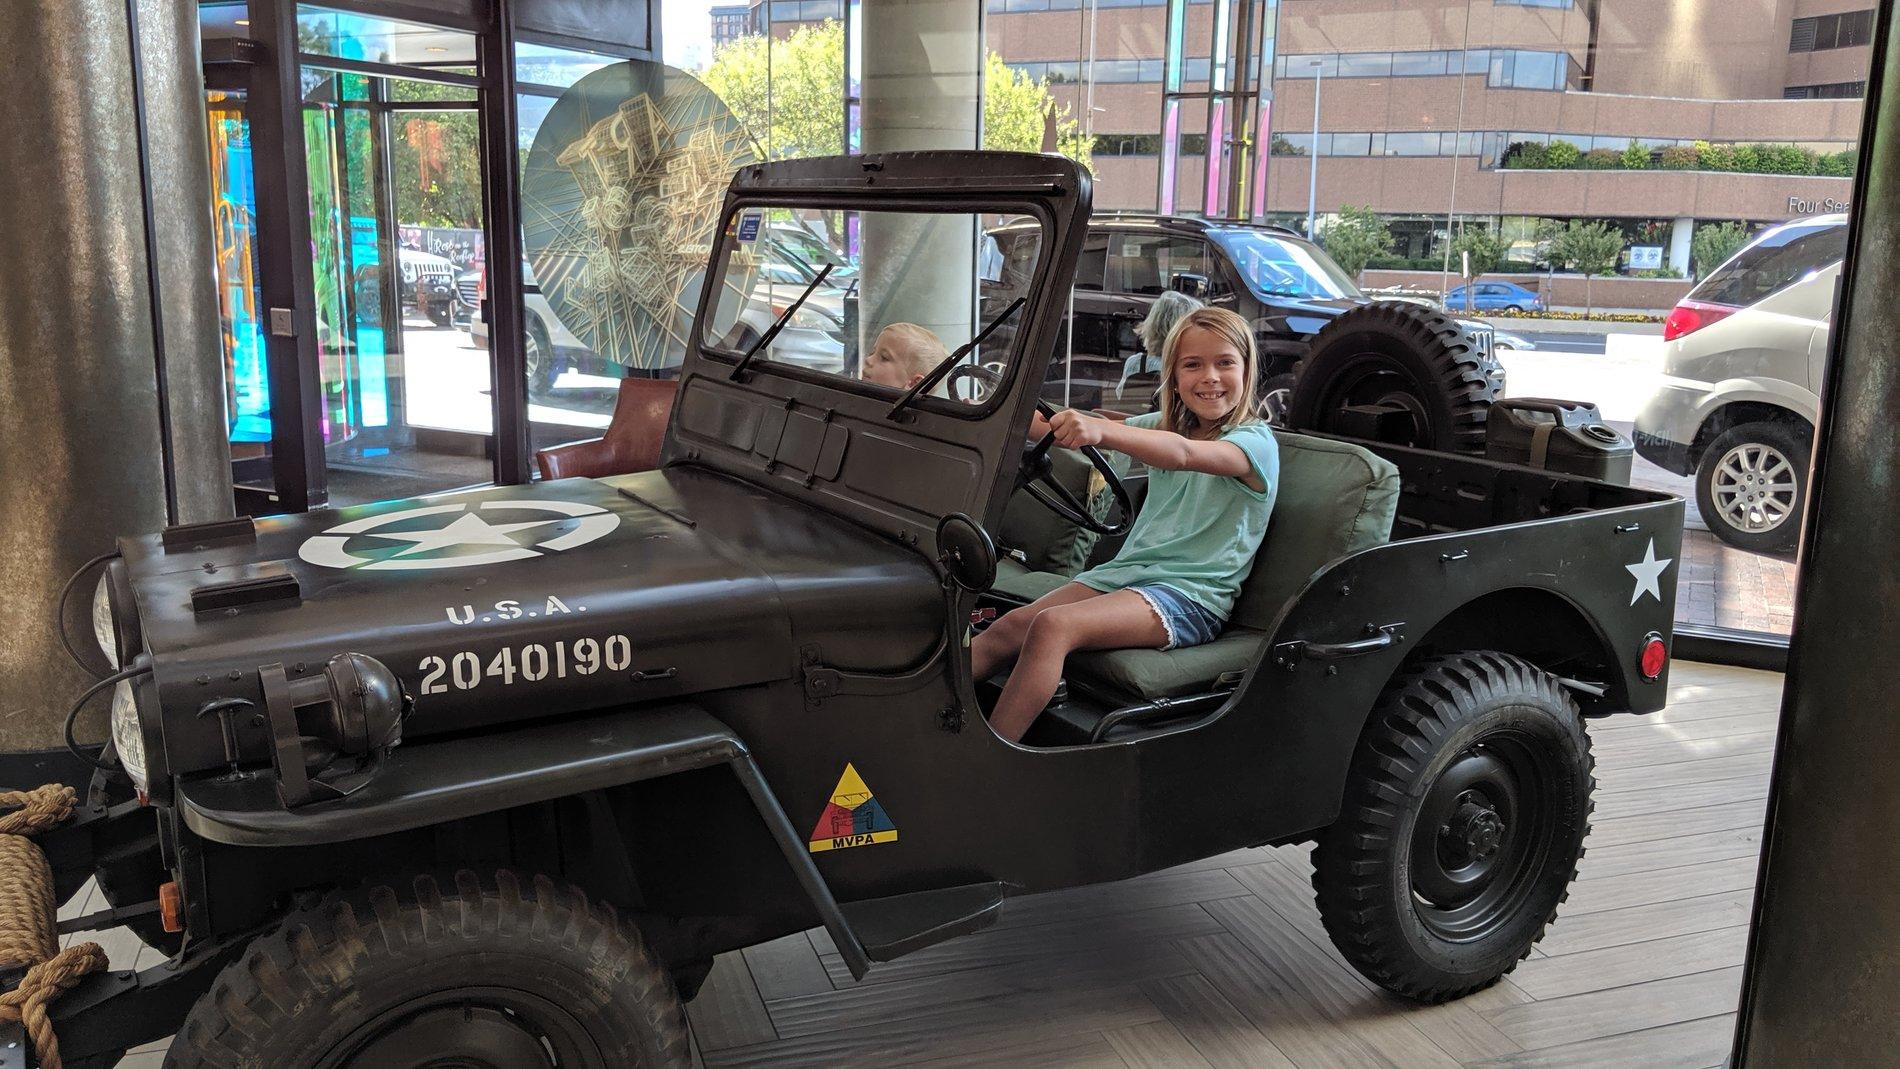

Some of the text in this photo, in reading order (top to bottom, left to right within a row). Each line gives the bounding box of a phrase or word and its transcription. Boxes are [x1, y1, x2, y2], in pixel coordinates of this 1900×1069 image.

[1787, 197, 1820, 213] Four
[446, 595, 587, 625] U.S.A.
[418, 634, 632, 695] 2040190
[832, 834, 875, 849] MVPA
